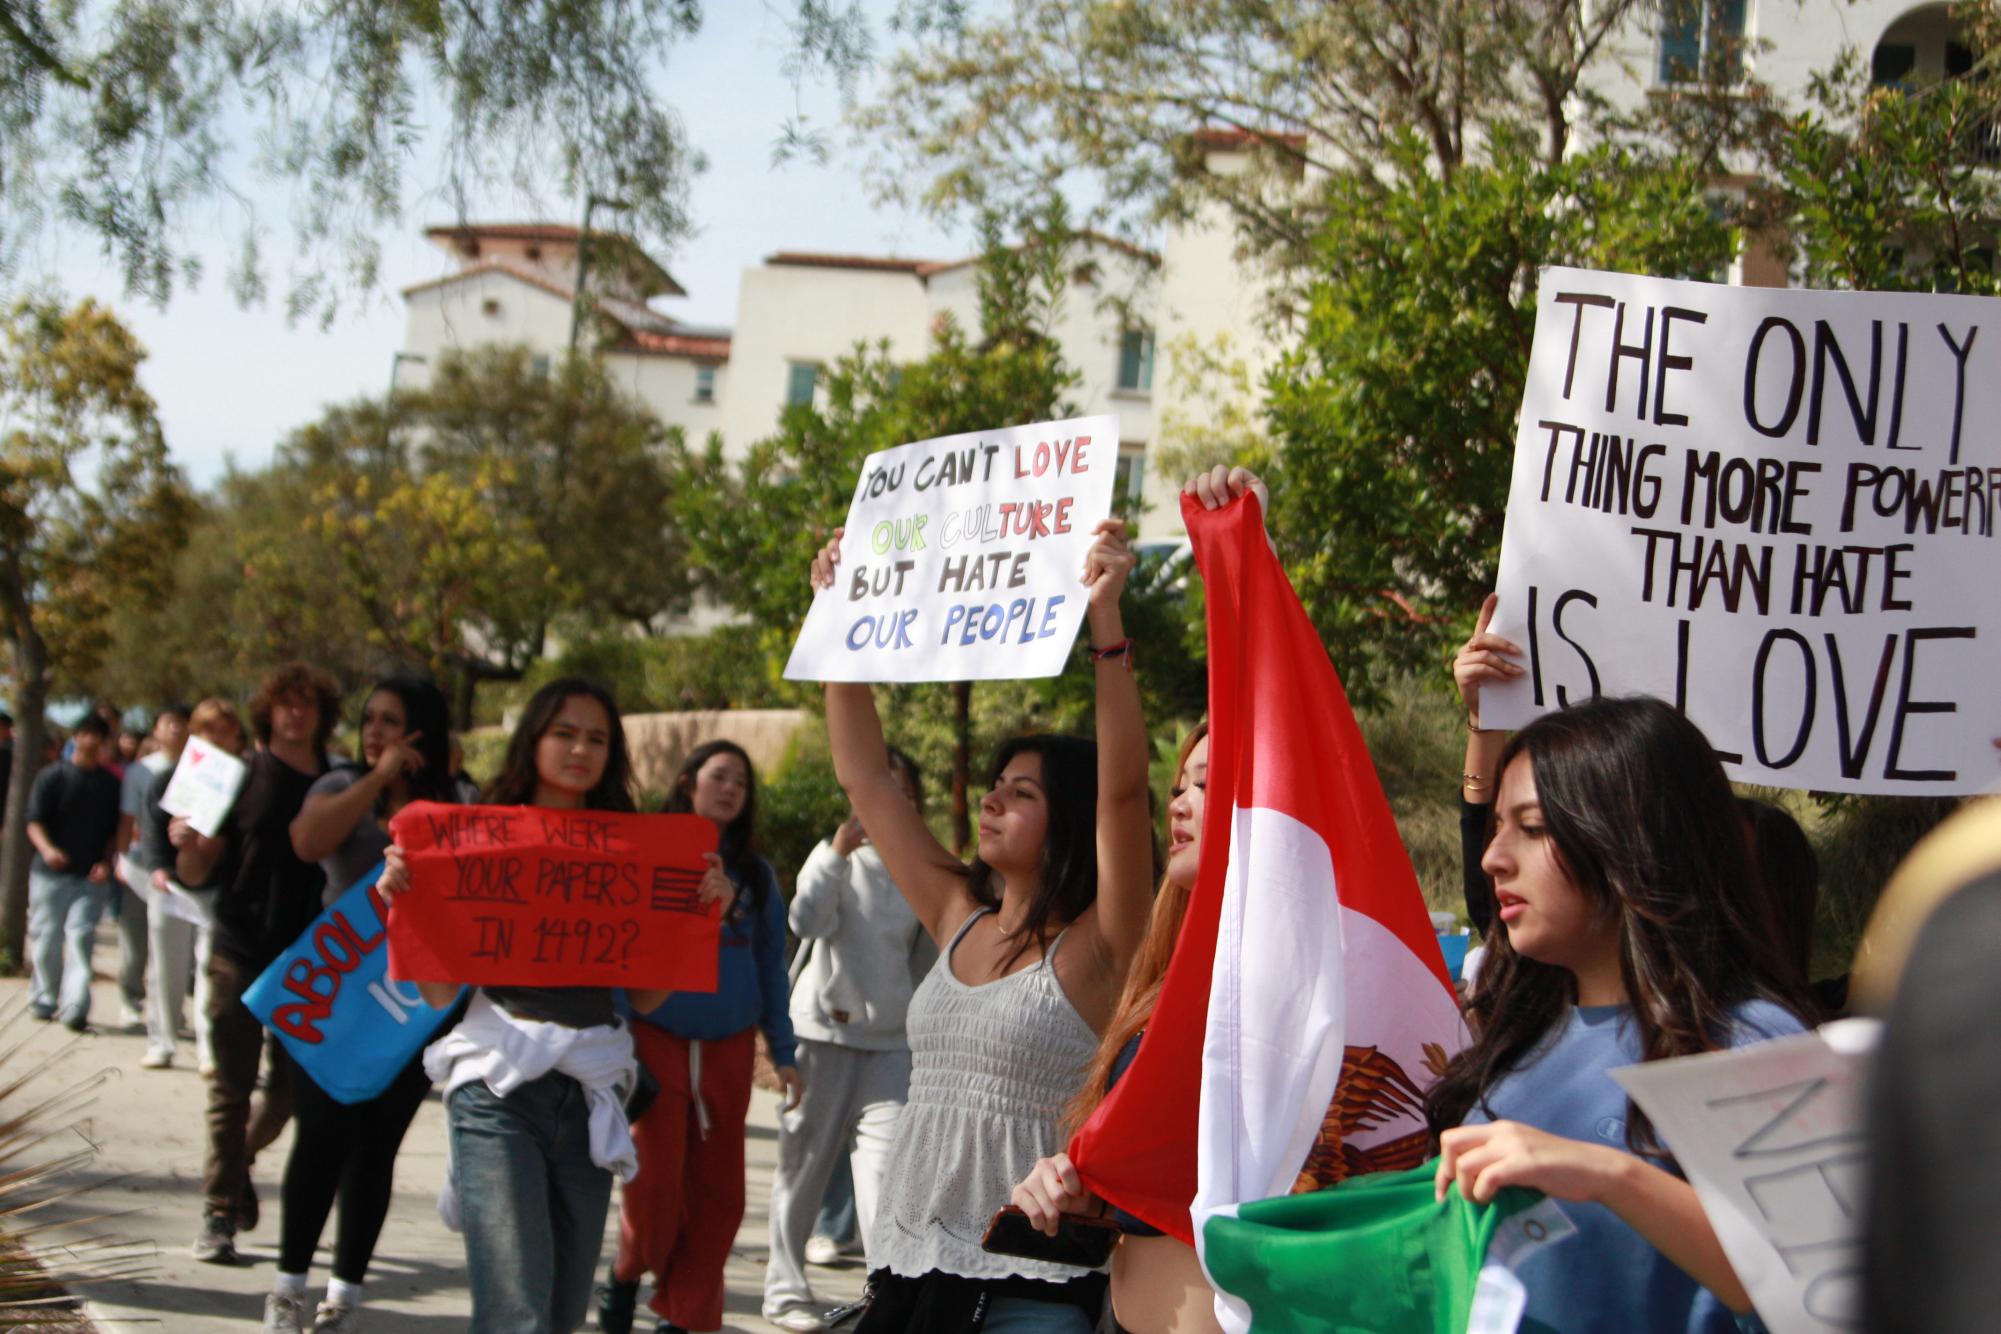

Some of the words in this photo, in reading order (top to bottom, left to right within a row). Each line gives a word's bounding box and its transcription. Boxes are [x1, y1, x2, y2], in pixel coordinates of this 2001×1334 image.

[1555, 292, 1707, 426] THE
[1744, 316, 1978, 465] ONLY
[860, 461, 905, 502] YOU
[913, 441, 999, 491] CAN'T
[1014, 436, 1092, 479] LOVE
[1538, 420, 1666, 519] THING
[1681, 449, 1822, 535] MORE
[871, 513, 928, 555] OUR
[939, 496, 1074, 549] CULTURE
[848, 560, 914, 601] BUT
[938, 551, 1030, 593] HATE
[1631, 527, 1773, 616] THAN
[1791, 544, 1914, 616] HATE
[845, 608, 918, 651] OUR
[941, 595, 1065, 646] PEOPLE
[1528, 586, 1601, 710] IS
[1676, 619, 1976, 782] LOVE
[428, 812, 517, 849] WHERE
[541, 816, 621, 853] WERE
[453, 856, 523, 899] YOUR
[536, 857, 641, 906] PAPERS
[471, 916, 515, 963] IN
[532, 915, 641, 969] 1492?
